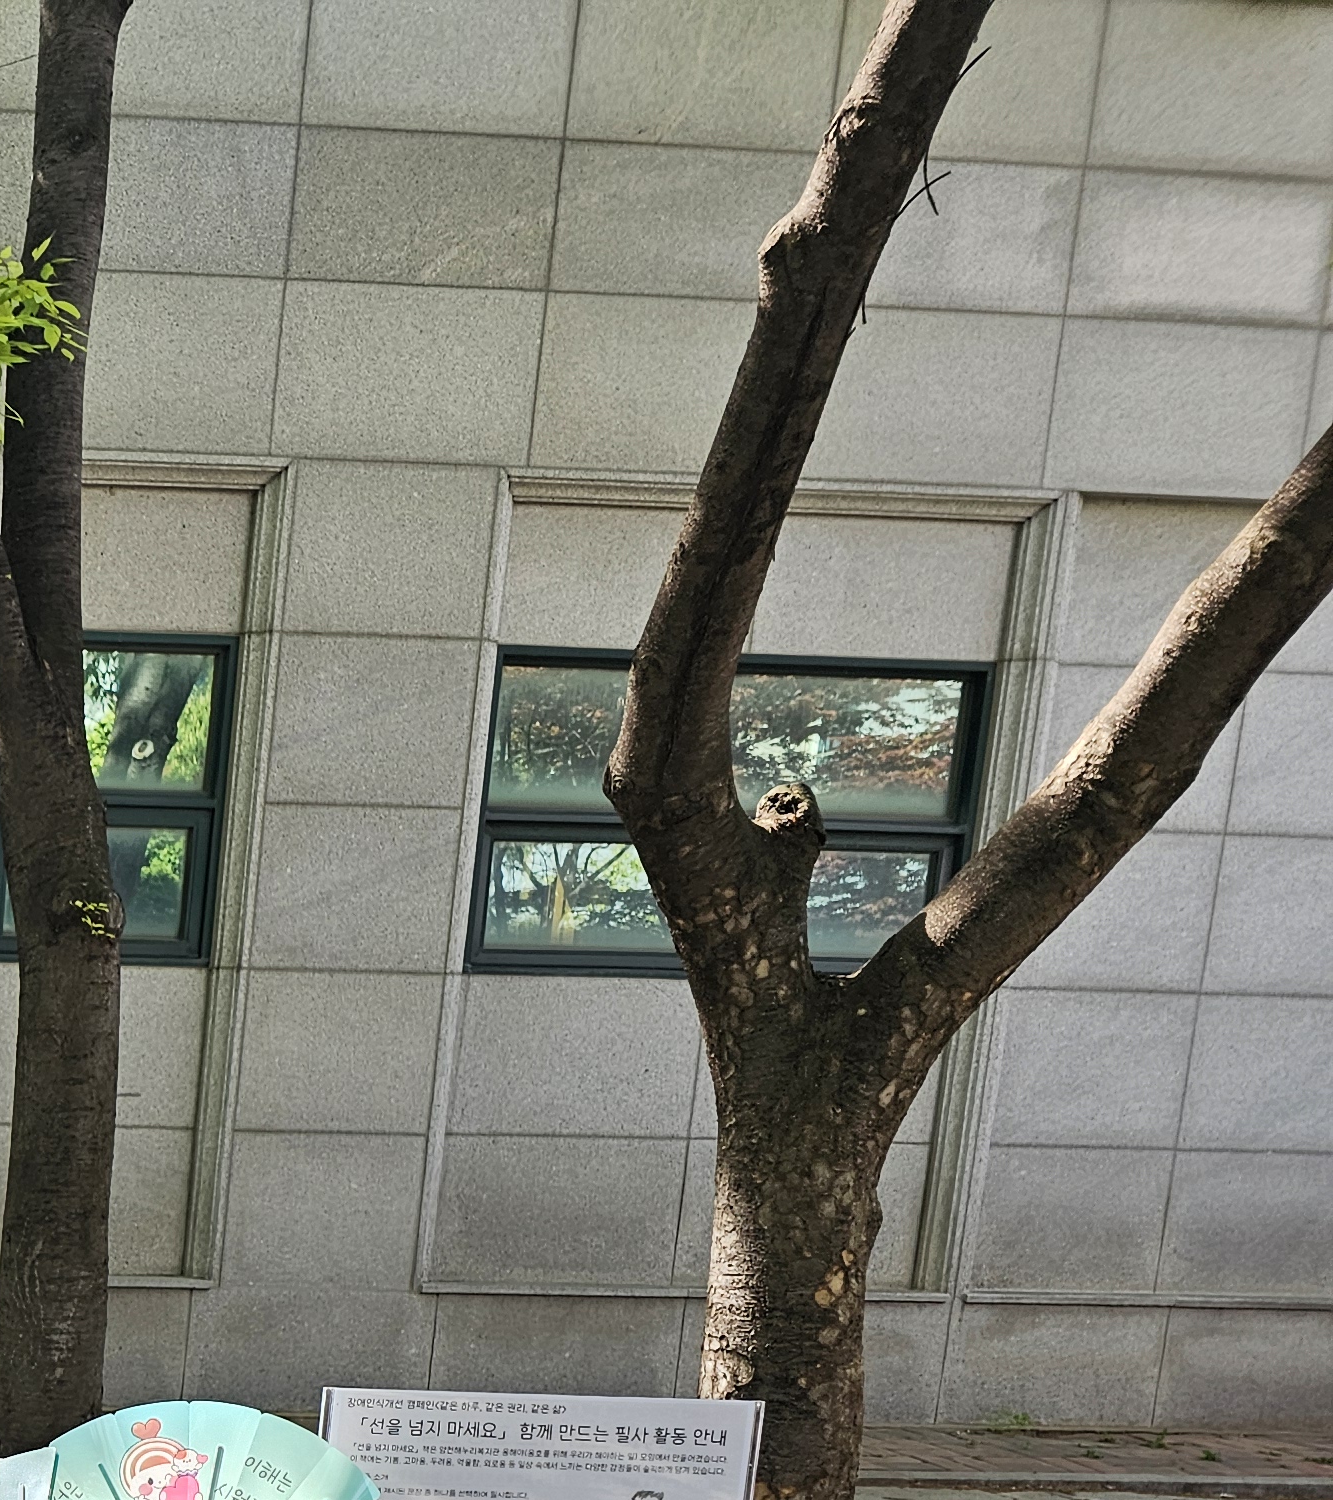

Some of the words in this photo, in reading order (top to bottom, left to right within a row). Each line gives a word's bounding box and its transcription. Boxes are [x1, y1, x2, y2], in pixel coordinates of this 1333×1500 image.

[347, 1397, 404, 1410] 장애인식개선
[485, 1402, 504, 1413] 같은
[531, 1403, 550, 1415] 같은
[409, 1418, 441, 1437] 넘지
[520, 1422, 553, 1441] 함께
[559, 1423, 610, 1443] 만드는
[615, 1425, 649, 1444] 필사
[653, 1426, 688, 1445] 활동
[693, 1428, 728, 1447] 안내
[244, 1454, 293, 1495] 이해는
